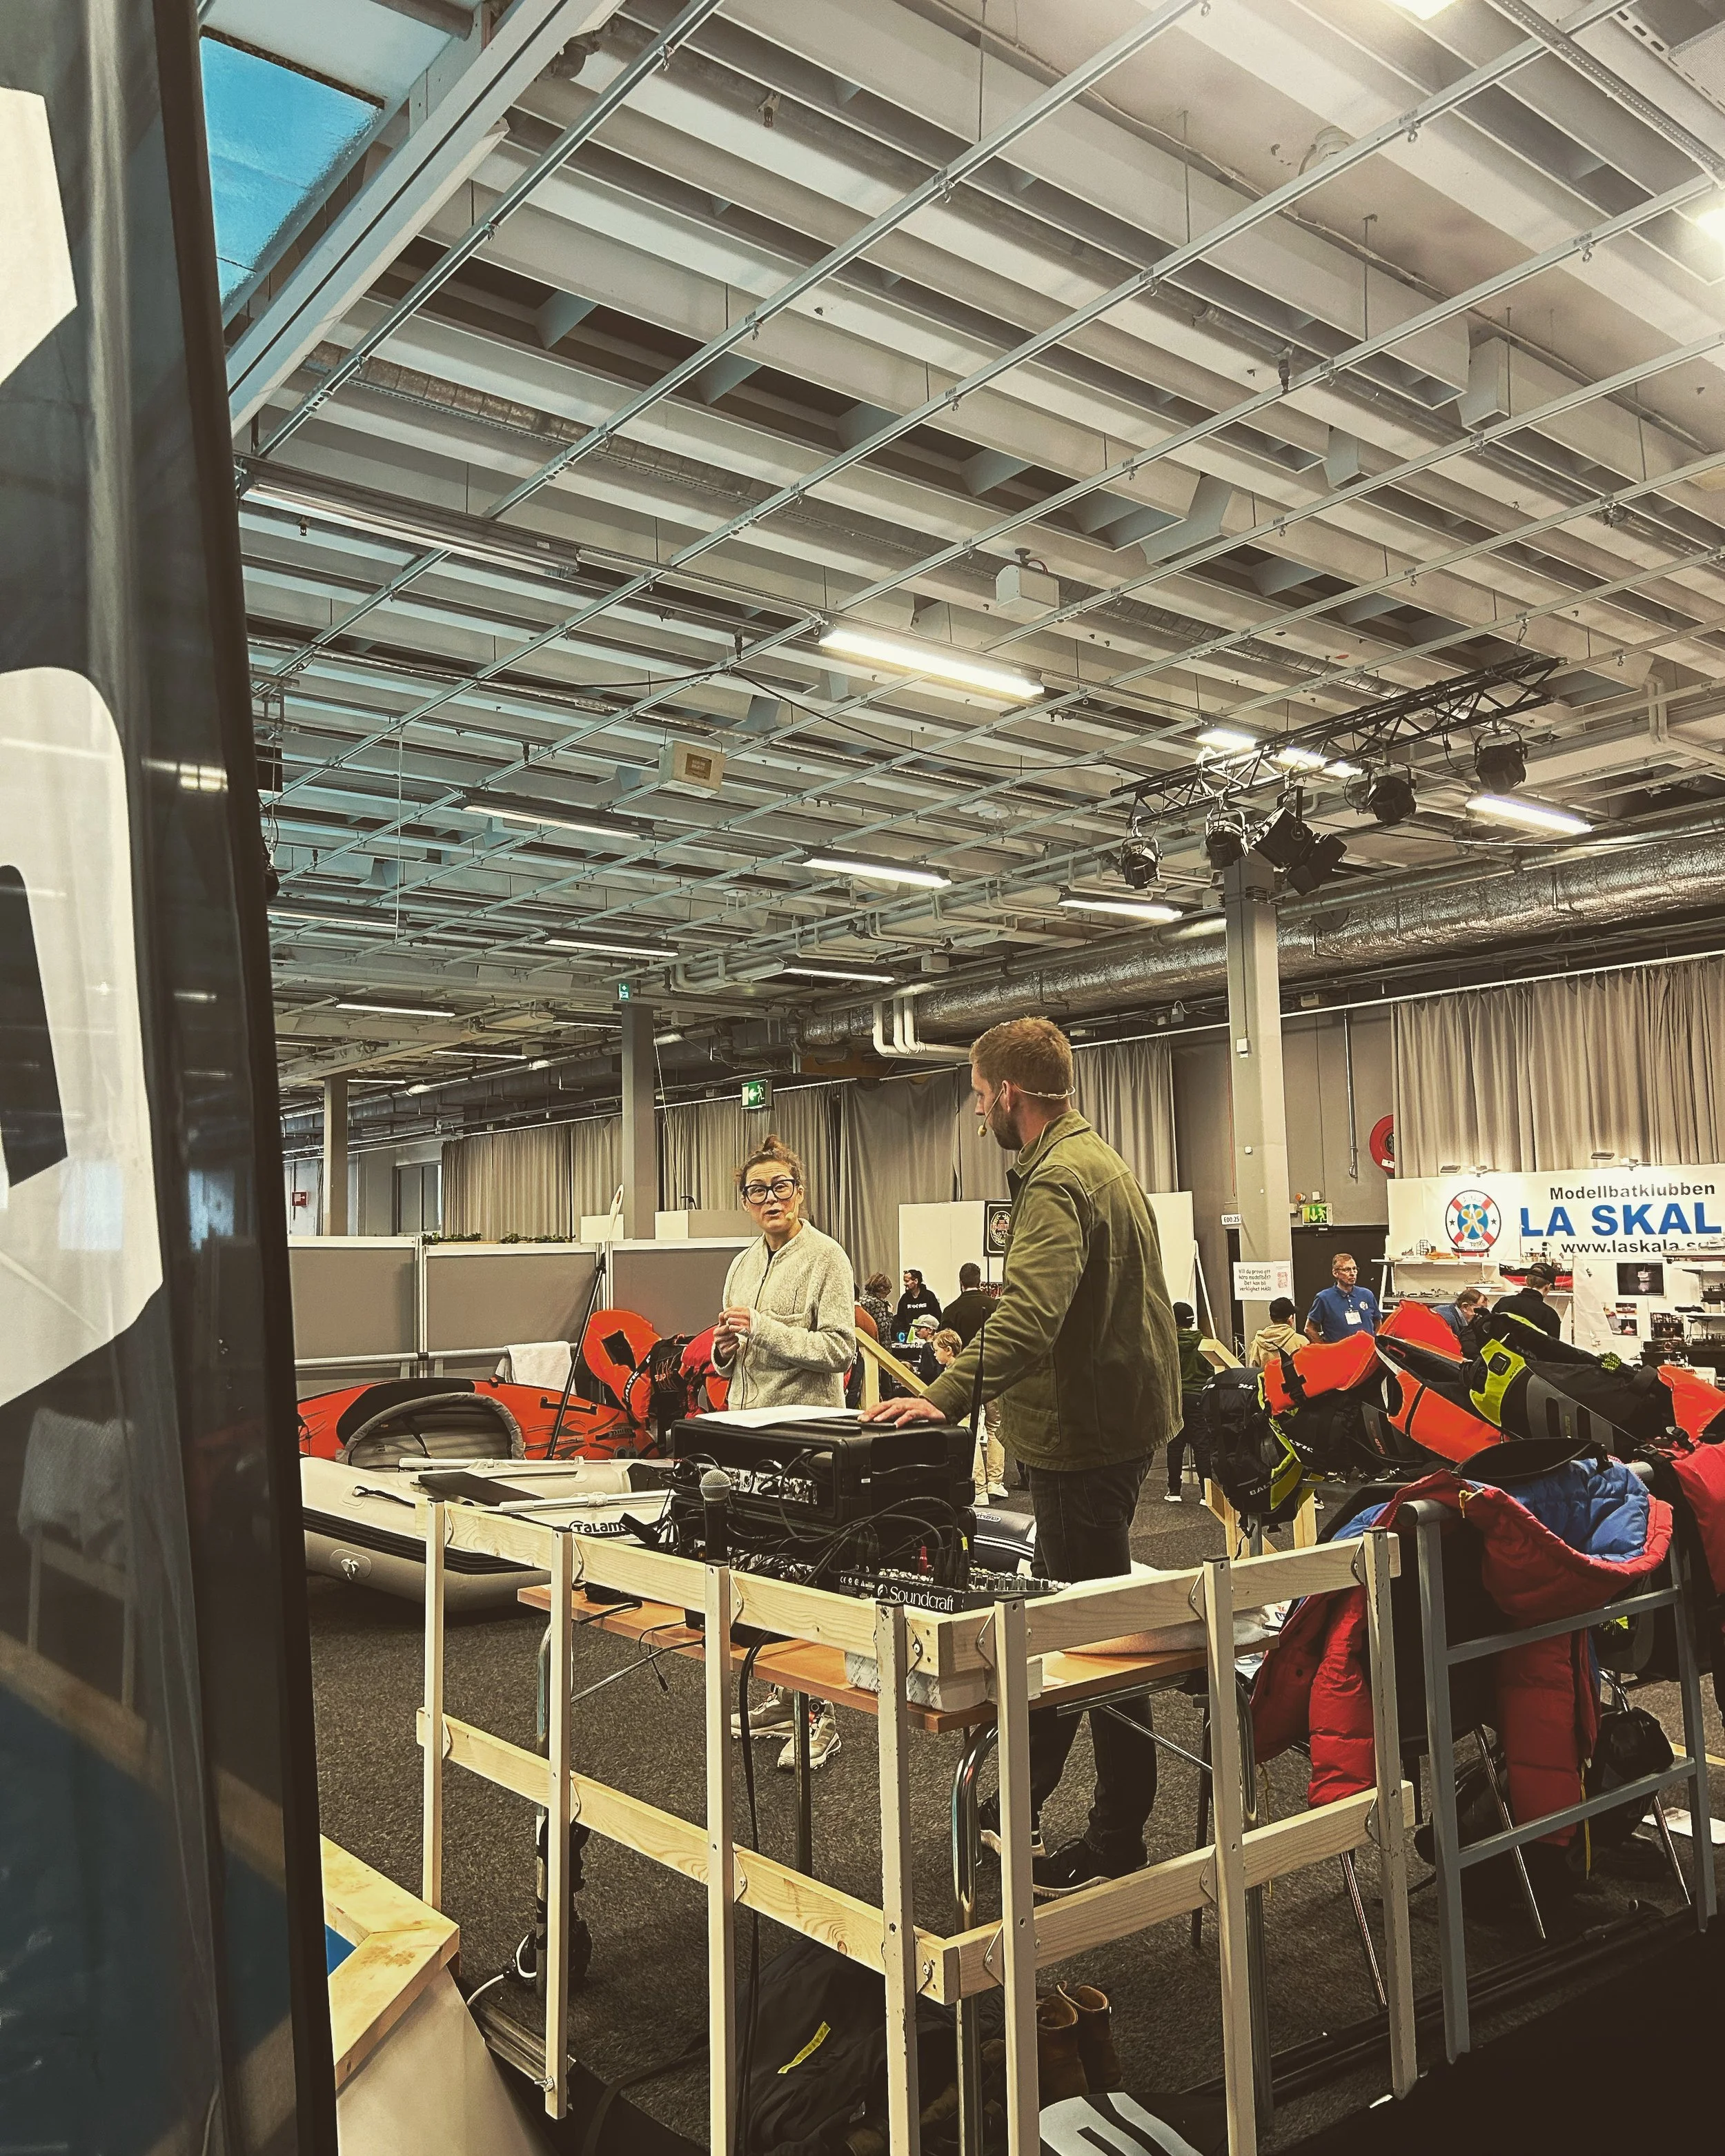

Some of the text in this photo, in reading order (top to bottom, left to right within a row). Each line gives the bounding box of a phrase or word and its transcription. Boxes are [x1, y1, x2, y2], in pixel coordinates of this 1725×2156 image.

[1520, 1202, 1722, 1237] LA SKAL
[889, 1585, 954, 1612] Soundcraft
